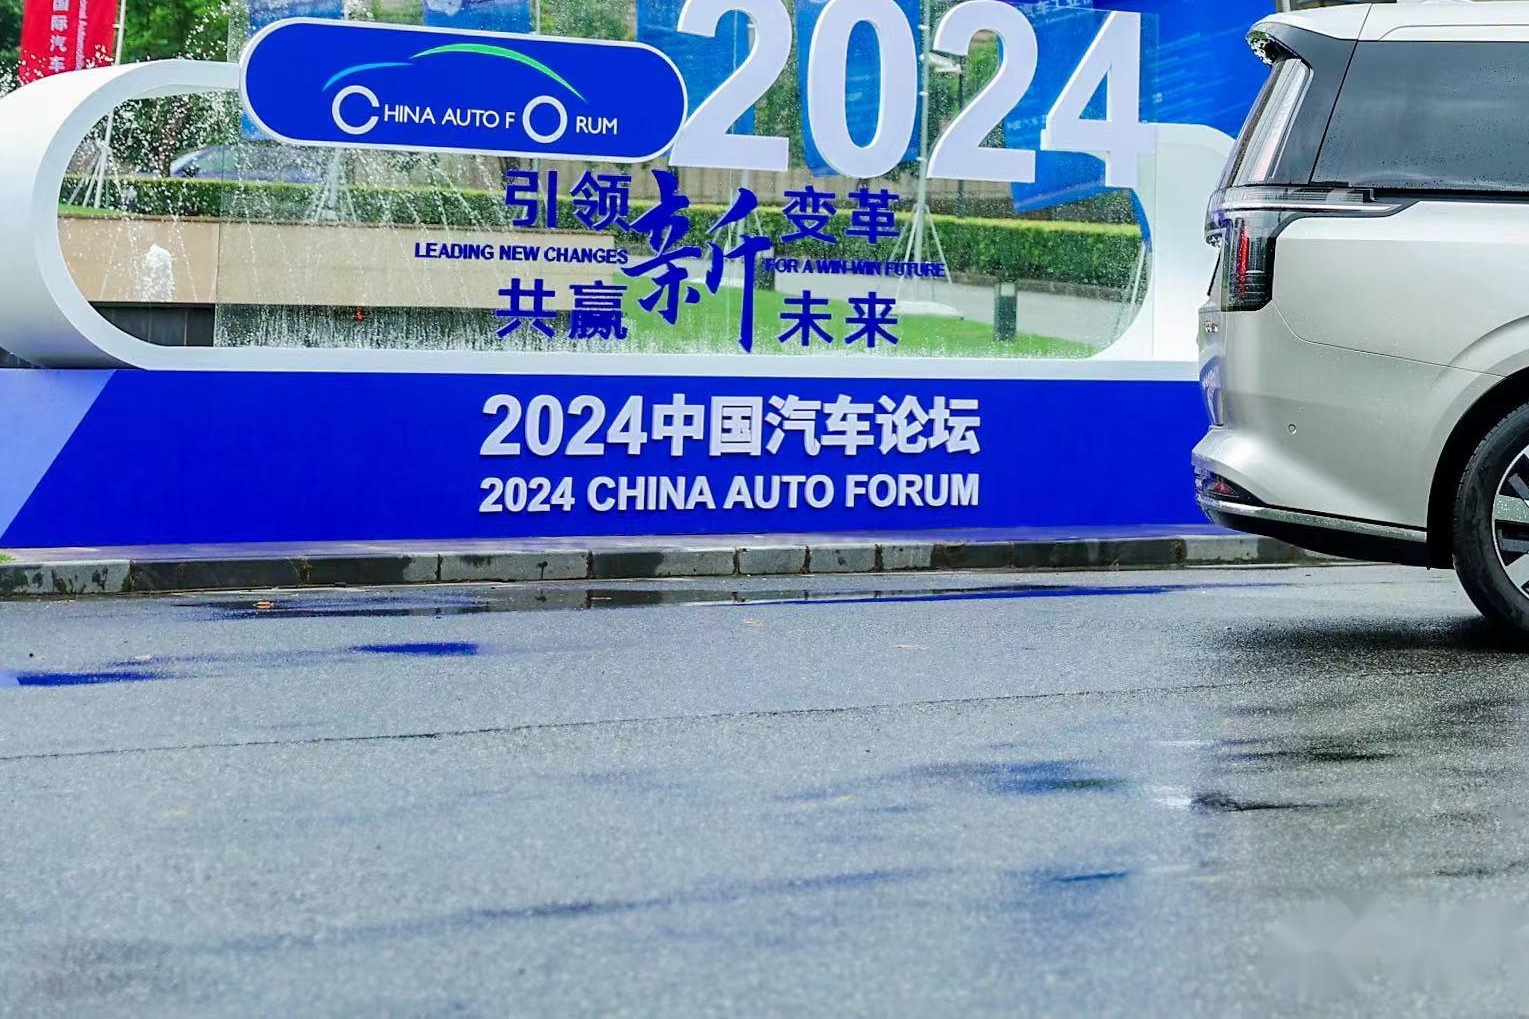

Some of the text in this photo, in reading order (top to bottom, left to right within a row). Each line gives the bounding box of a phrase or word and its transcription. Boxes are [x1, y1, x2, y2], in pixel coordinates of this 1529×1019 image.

[331, 85, 437, 135] CHINA
[441, 108, 500, 129] AUTO
[505, 169, 631, 233] 引领
[780, 185, 901, 246] 变革
[414, 242, 629, 265] LEADING NEW CHANGES
[764, 258, 946, 278] FOR A WIN-WIN FUTURE
[496, 278, 899, 348] 共赢 未来
[479, 393, 981, 457] 2024中国汽车论坛
[478, 473, 980, 513] 2024 CHINA AUTO FORUM
